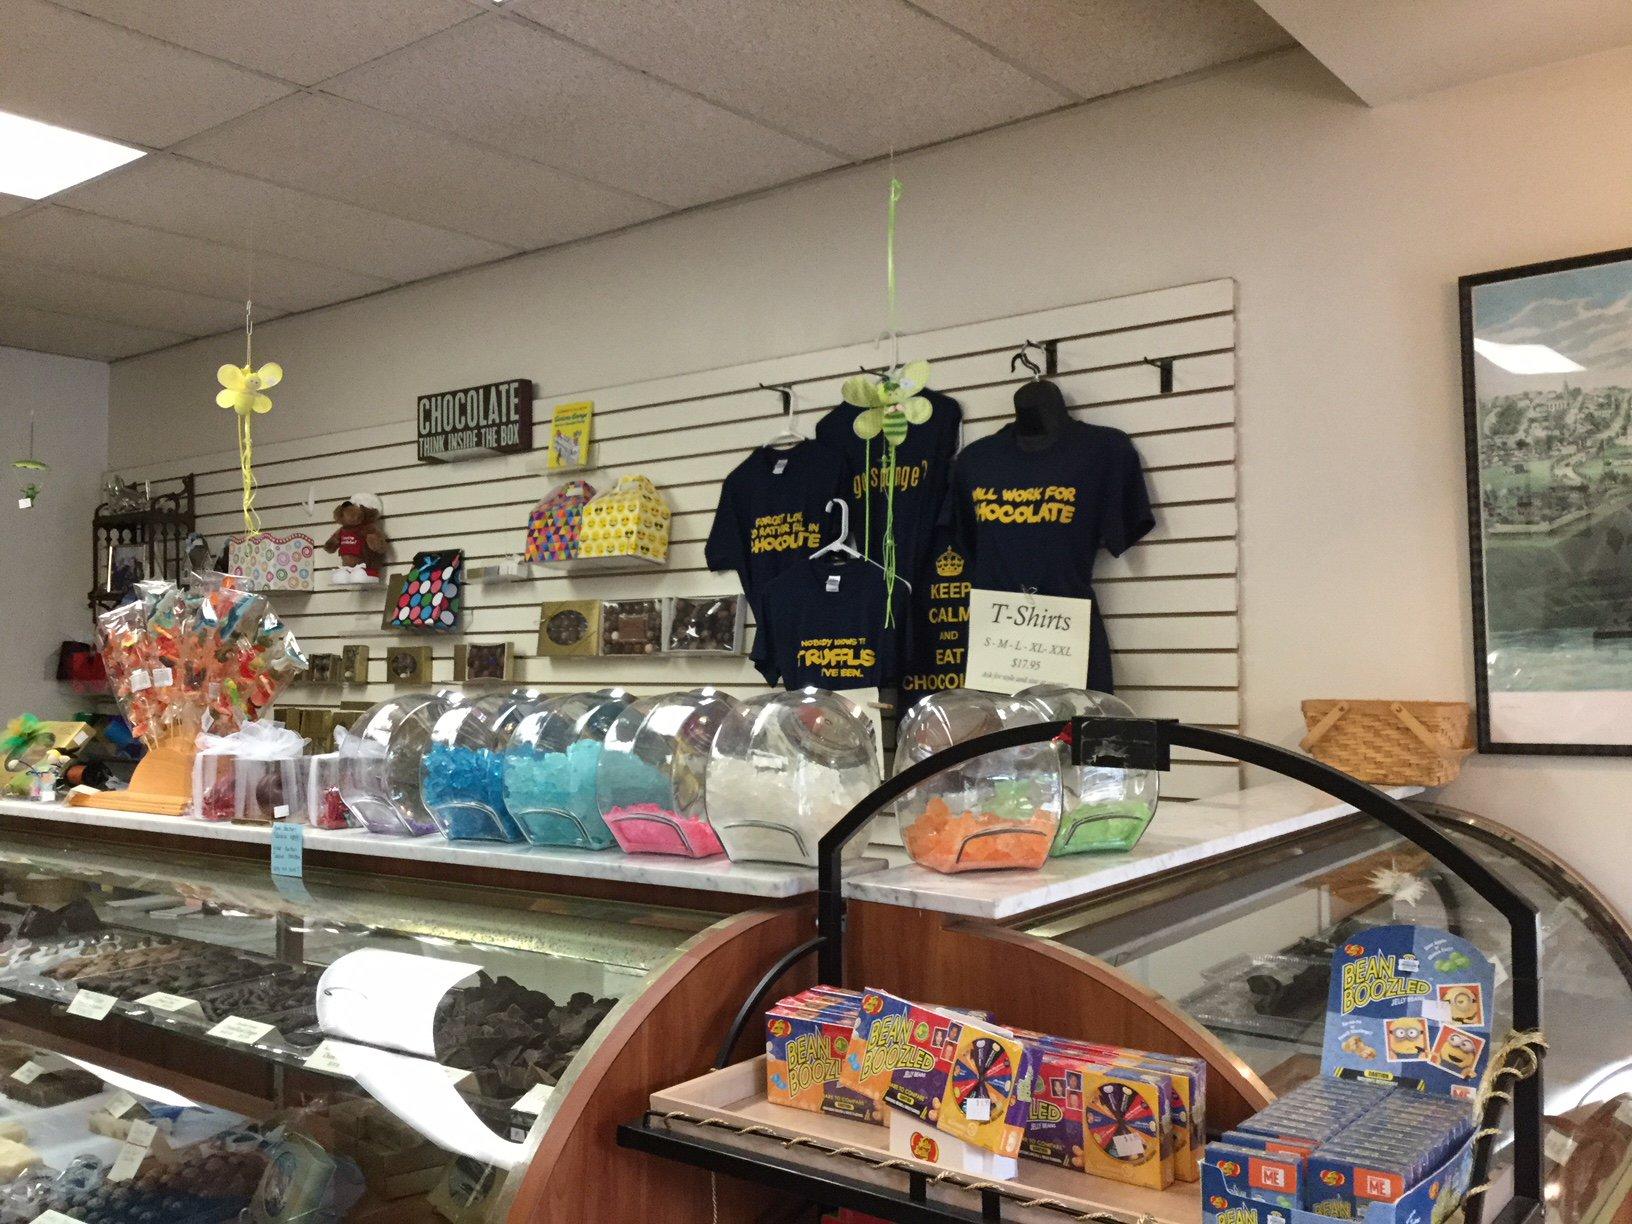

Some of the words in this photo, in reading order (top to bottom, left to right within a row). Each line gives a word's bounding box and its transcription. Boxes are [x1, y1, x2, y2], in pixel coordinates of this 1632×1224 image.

[420, 382, 520, 435] CHOCOLATE
[419, 434, 446, 459] THINK
[448, 429, 478, 452] INSIDE
[481, 426, 498, 449] THE
[501, 423, 520, 447] BOX
[1044, 485, 1077, 502] FOR
[975, 502, 1076, 524] HOCOLATE
[931, 582, 971, 599] KEEP
[929, 607, 970, 624] CALM
[993, 603, 1072, 632] T-Shirts
[939, 630, 959, 641] AND
[936, 648, 964, 665] EAT
[1343, 951, 1397, 991] BEAN
[1342, 978, 1432, 1016] BOOZLED
[868, 1010, 916, 1051] BEAN
[786, 1029, 832, 1070] BEAN
[860, 1043, 937, 1082] BOOZLED
[787, 1058, 842, 1099] BOOZL
